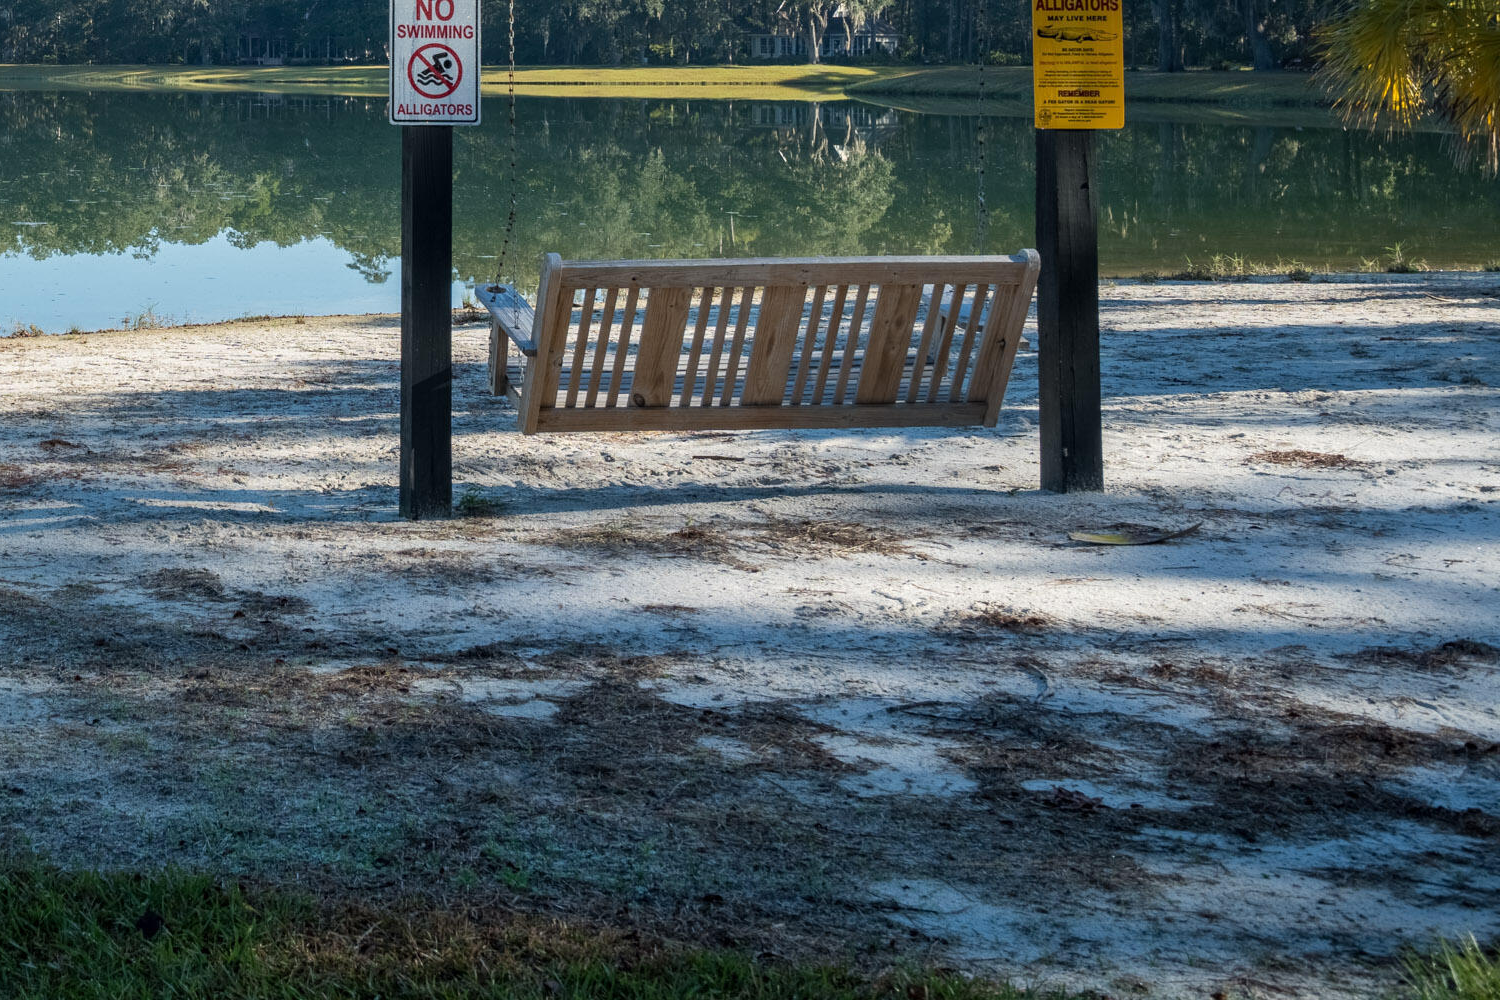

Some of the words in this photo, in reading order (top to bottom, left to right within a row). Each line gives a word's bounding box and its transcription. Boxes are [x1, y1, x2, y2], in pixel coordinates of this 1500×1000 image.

[397, 24, 474, 39] SWIMMING
[1057, 90, 1100, 98] REMEMBER
[397, 104, 473, 115] ALLIGATORS
